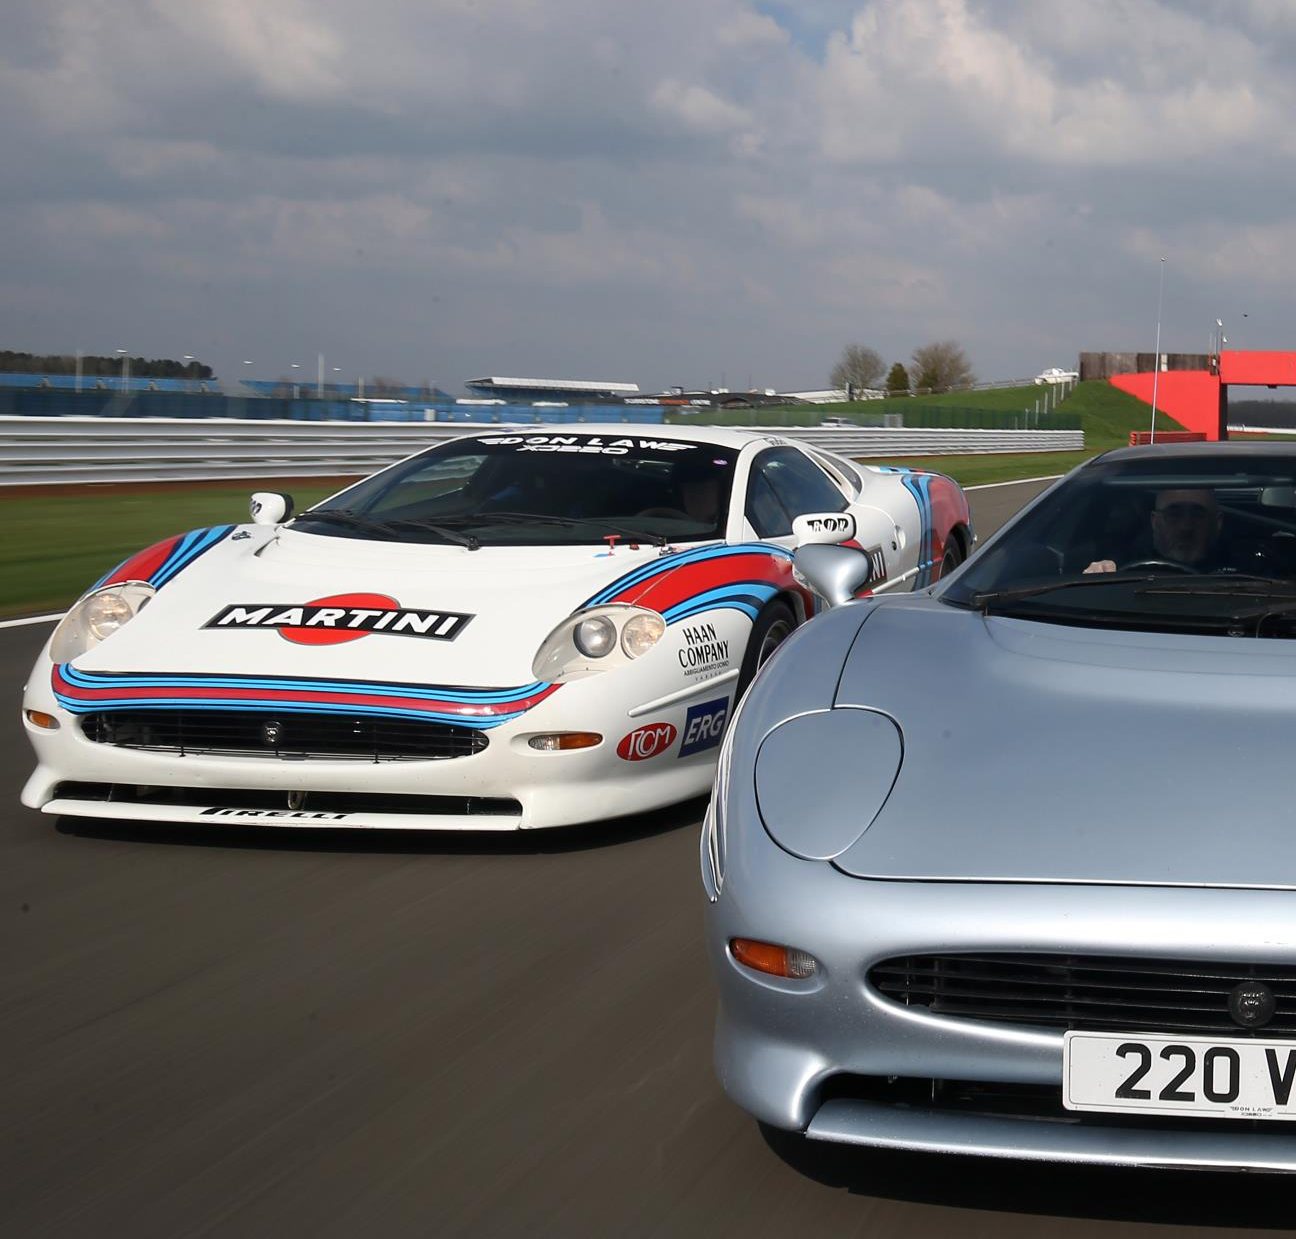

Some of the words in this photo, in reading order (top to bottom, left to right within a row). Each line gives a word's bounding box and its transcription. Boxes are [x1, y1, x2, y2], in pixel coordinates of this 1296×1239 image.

[500, 437, 578, 445] DON
[587, 438, 664, 450] LAW
[216, 607, 459, 636] MARTINI
[682, 623, 717, 646] HAAN
[678, 640, 729, 668] COMPANY
[684, 709, 726, 746] ERG
[1115, 1042, 1240, 1103] 220
